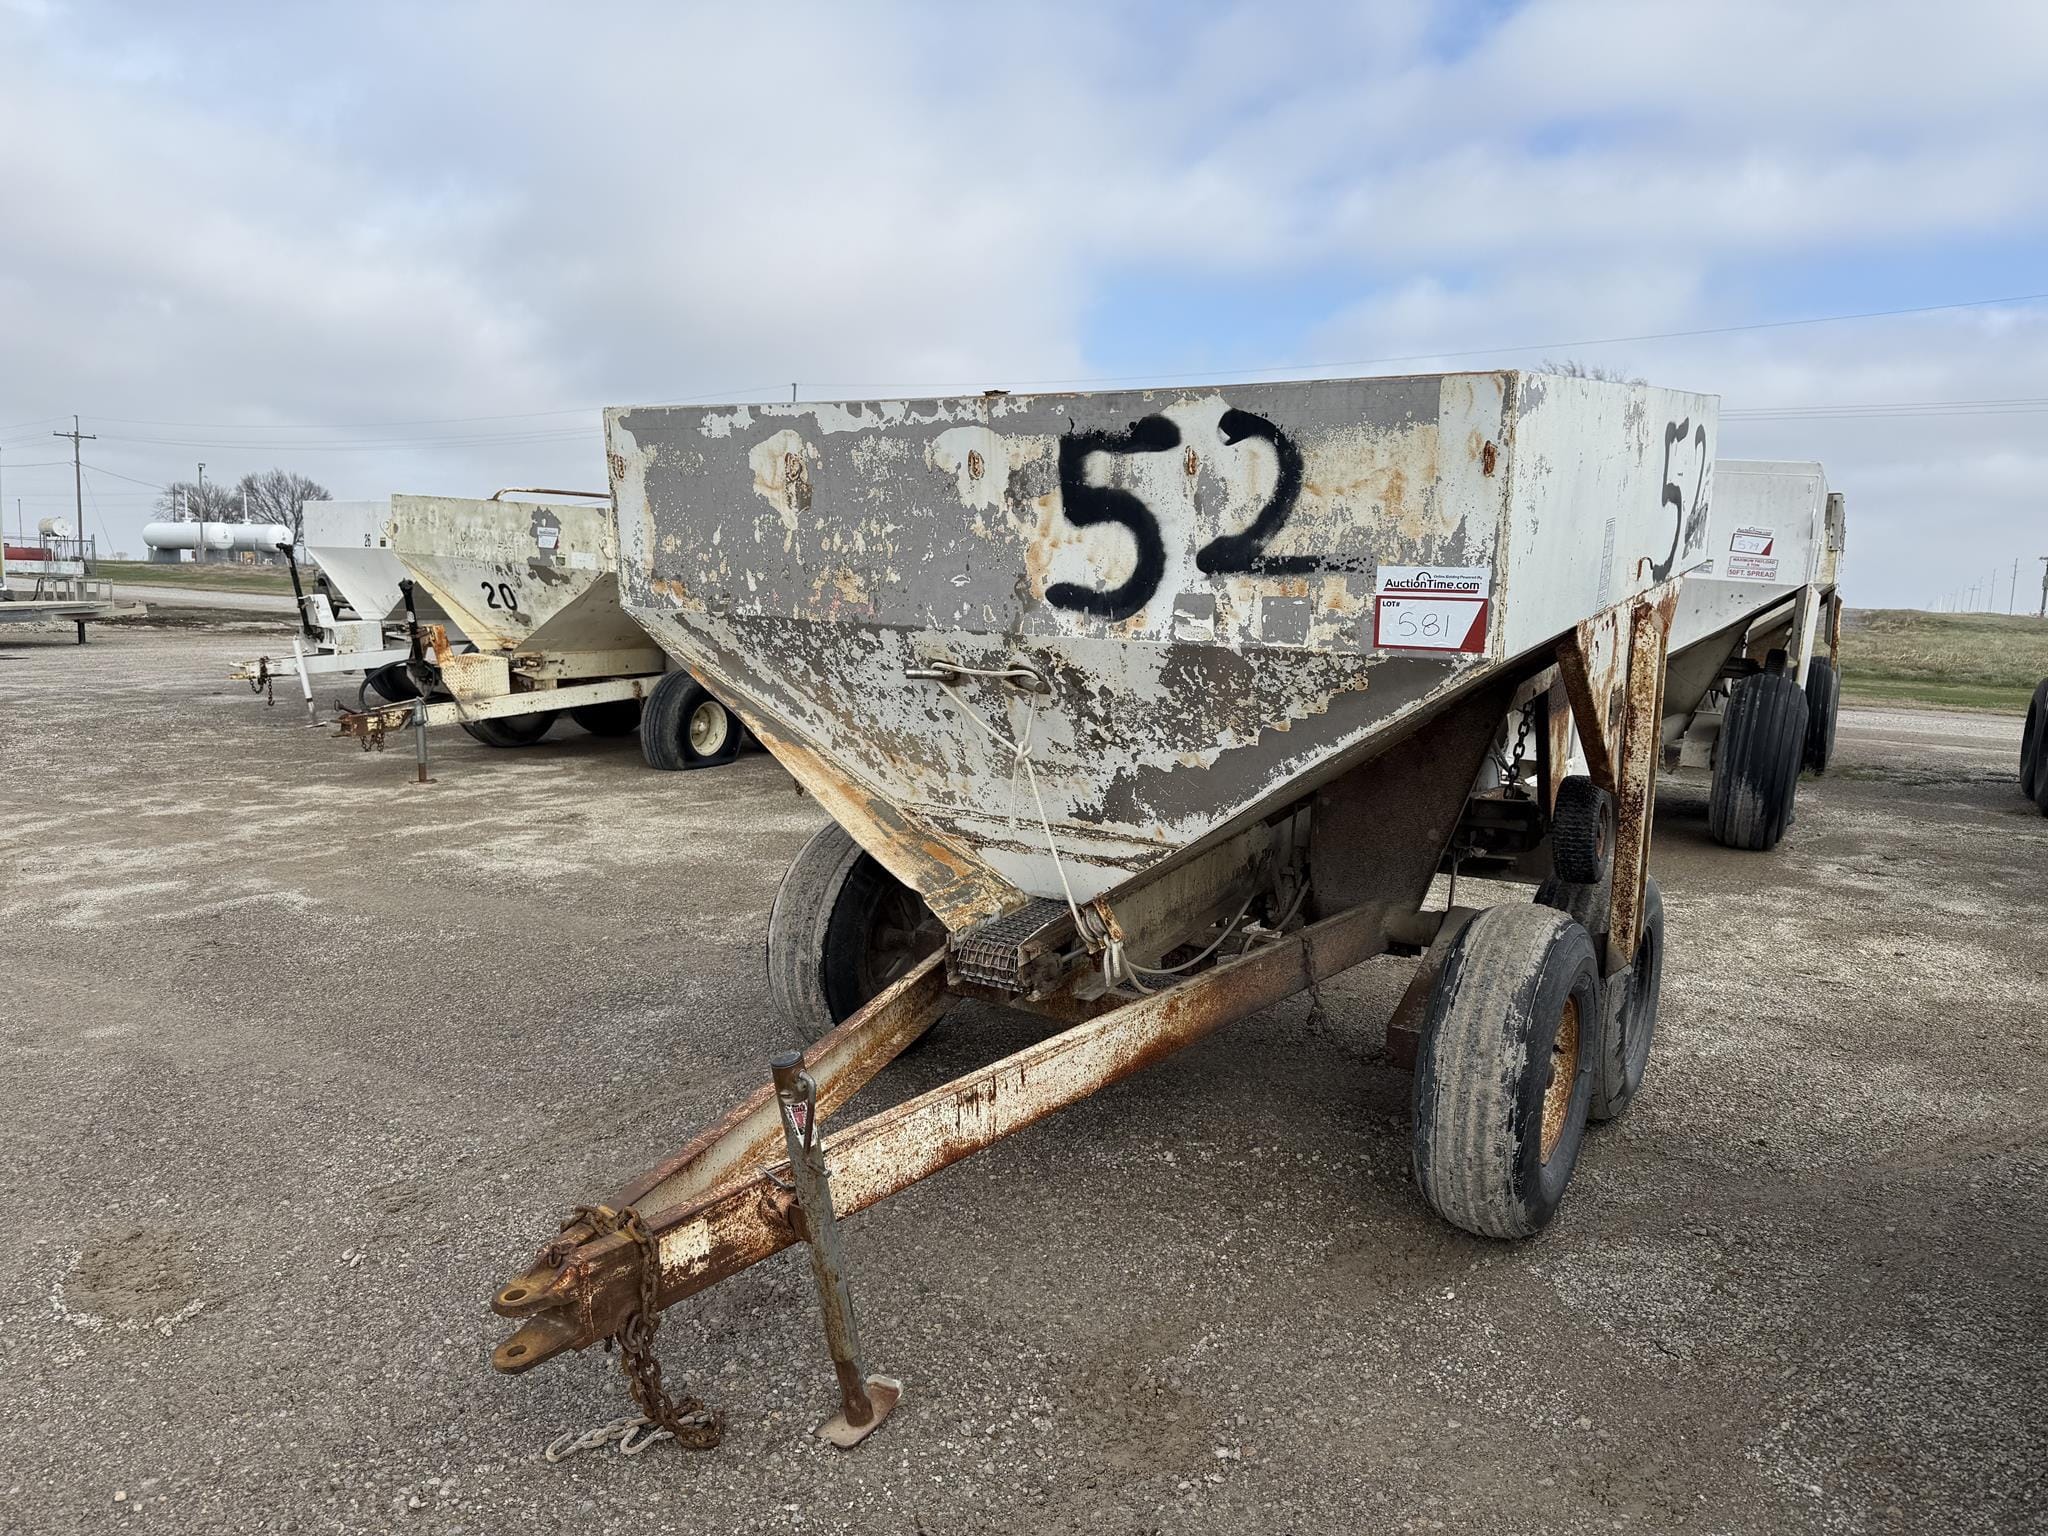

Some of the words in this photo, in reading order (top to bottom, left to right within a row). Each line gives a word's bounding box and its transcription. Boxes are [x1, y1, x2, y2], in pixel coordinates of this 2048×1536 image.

[1045, 407, 1362, 622] 52
[481, 581, 518, 611] 20
[1385, 579, 1480, 590] AuctionTime.com
[1382, 600, 1401, 608] LOT#
[1398, 611, 1450, 637] 581
